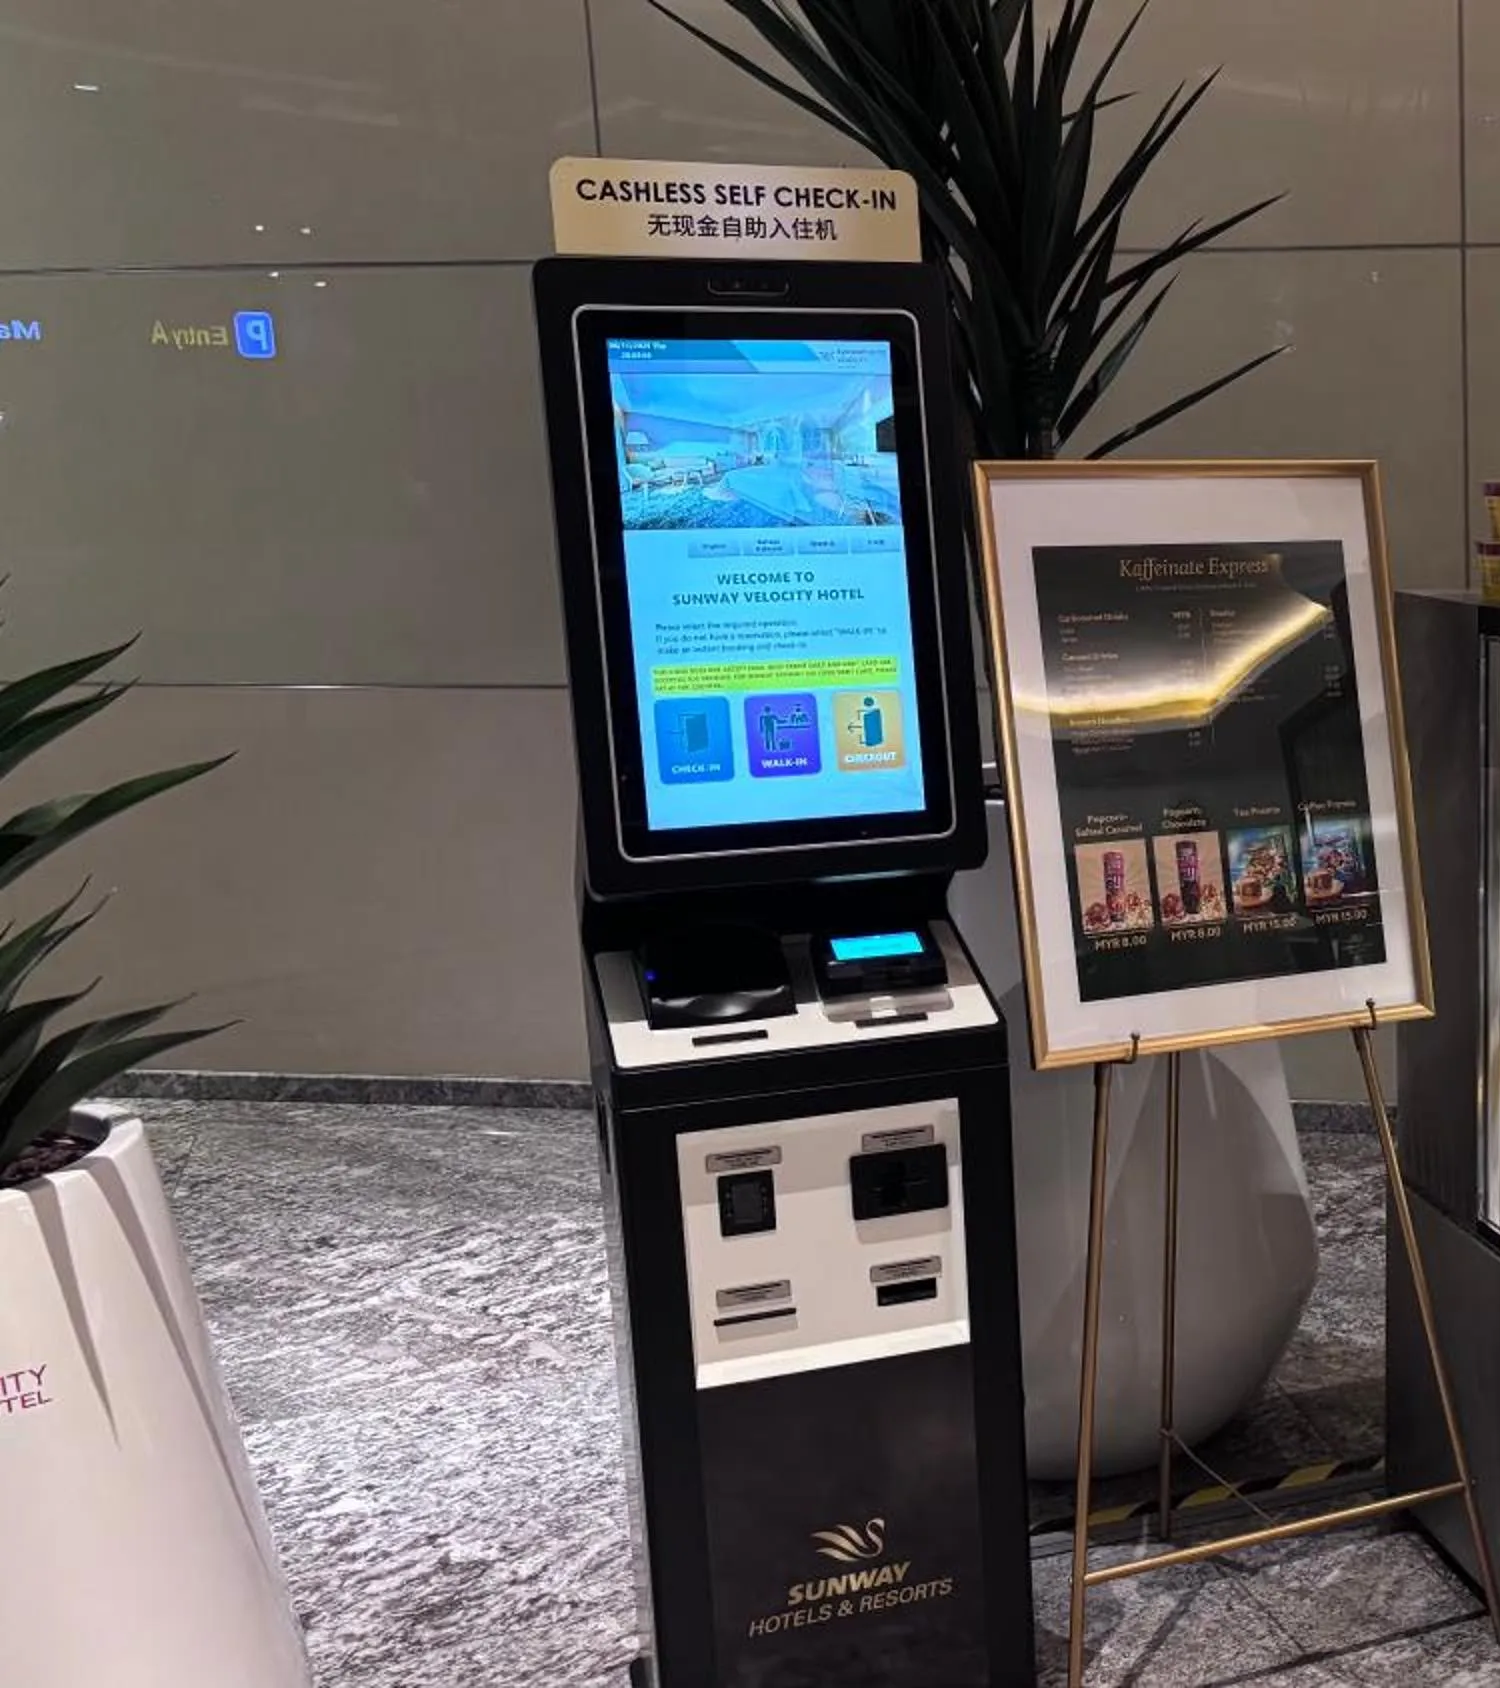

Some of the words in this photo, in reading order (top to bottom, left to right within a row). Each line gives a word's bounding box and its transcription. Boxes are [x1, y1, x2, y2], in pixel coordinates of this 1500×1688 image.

[576, 178, 706, 205] CASHLESS
[714, 183, 767, 206] SELF
[773, 187, 897, 211] CHECK-IN
[647, 213, 838, 241] 无现金自助入住机
[717, 572, 791, 585] WELCOME
[793, 571, 815, 583] TO
[1119, 556, 1205, 582] Kaffeinate
[1208, 556, 1269, 580] Express
[672, 591, 739, 606] SUNWAY
[744, 589, 814, 604] VELOCITY
[817, 588, 865, 601] HOTEL
[761, 758, 807, 769] WALK-IN
[787, 1560, 912, 1606] SUNWAY
[749, 1603, 833, 1638] HOTELS
[837, 1599, 854, 1617] &
[859, 1578, 953, 1612] RESORTS
